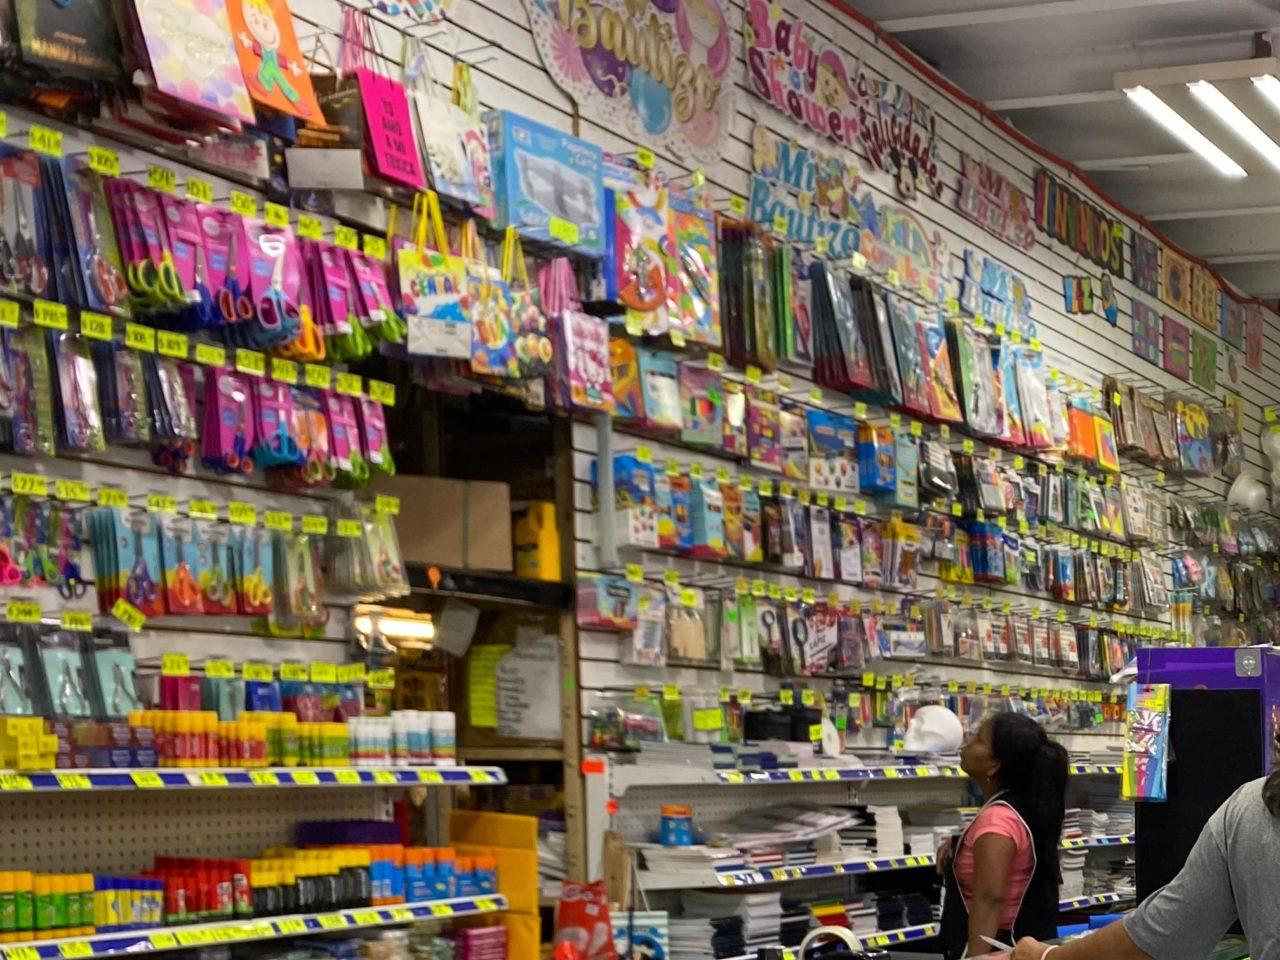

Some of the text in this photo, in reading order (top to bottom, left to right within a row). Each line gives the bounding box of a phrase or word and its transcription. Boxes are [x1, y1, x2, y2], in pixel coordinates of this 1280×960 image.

[749, 0, 818, 93] Baby
[749, 47, 858, 147] Shower
[780, 141, 817, 192] Mi
[751, 175, 860, 260] Bautizo
